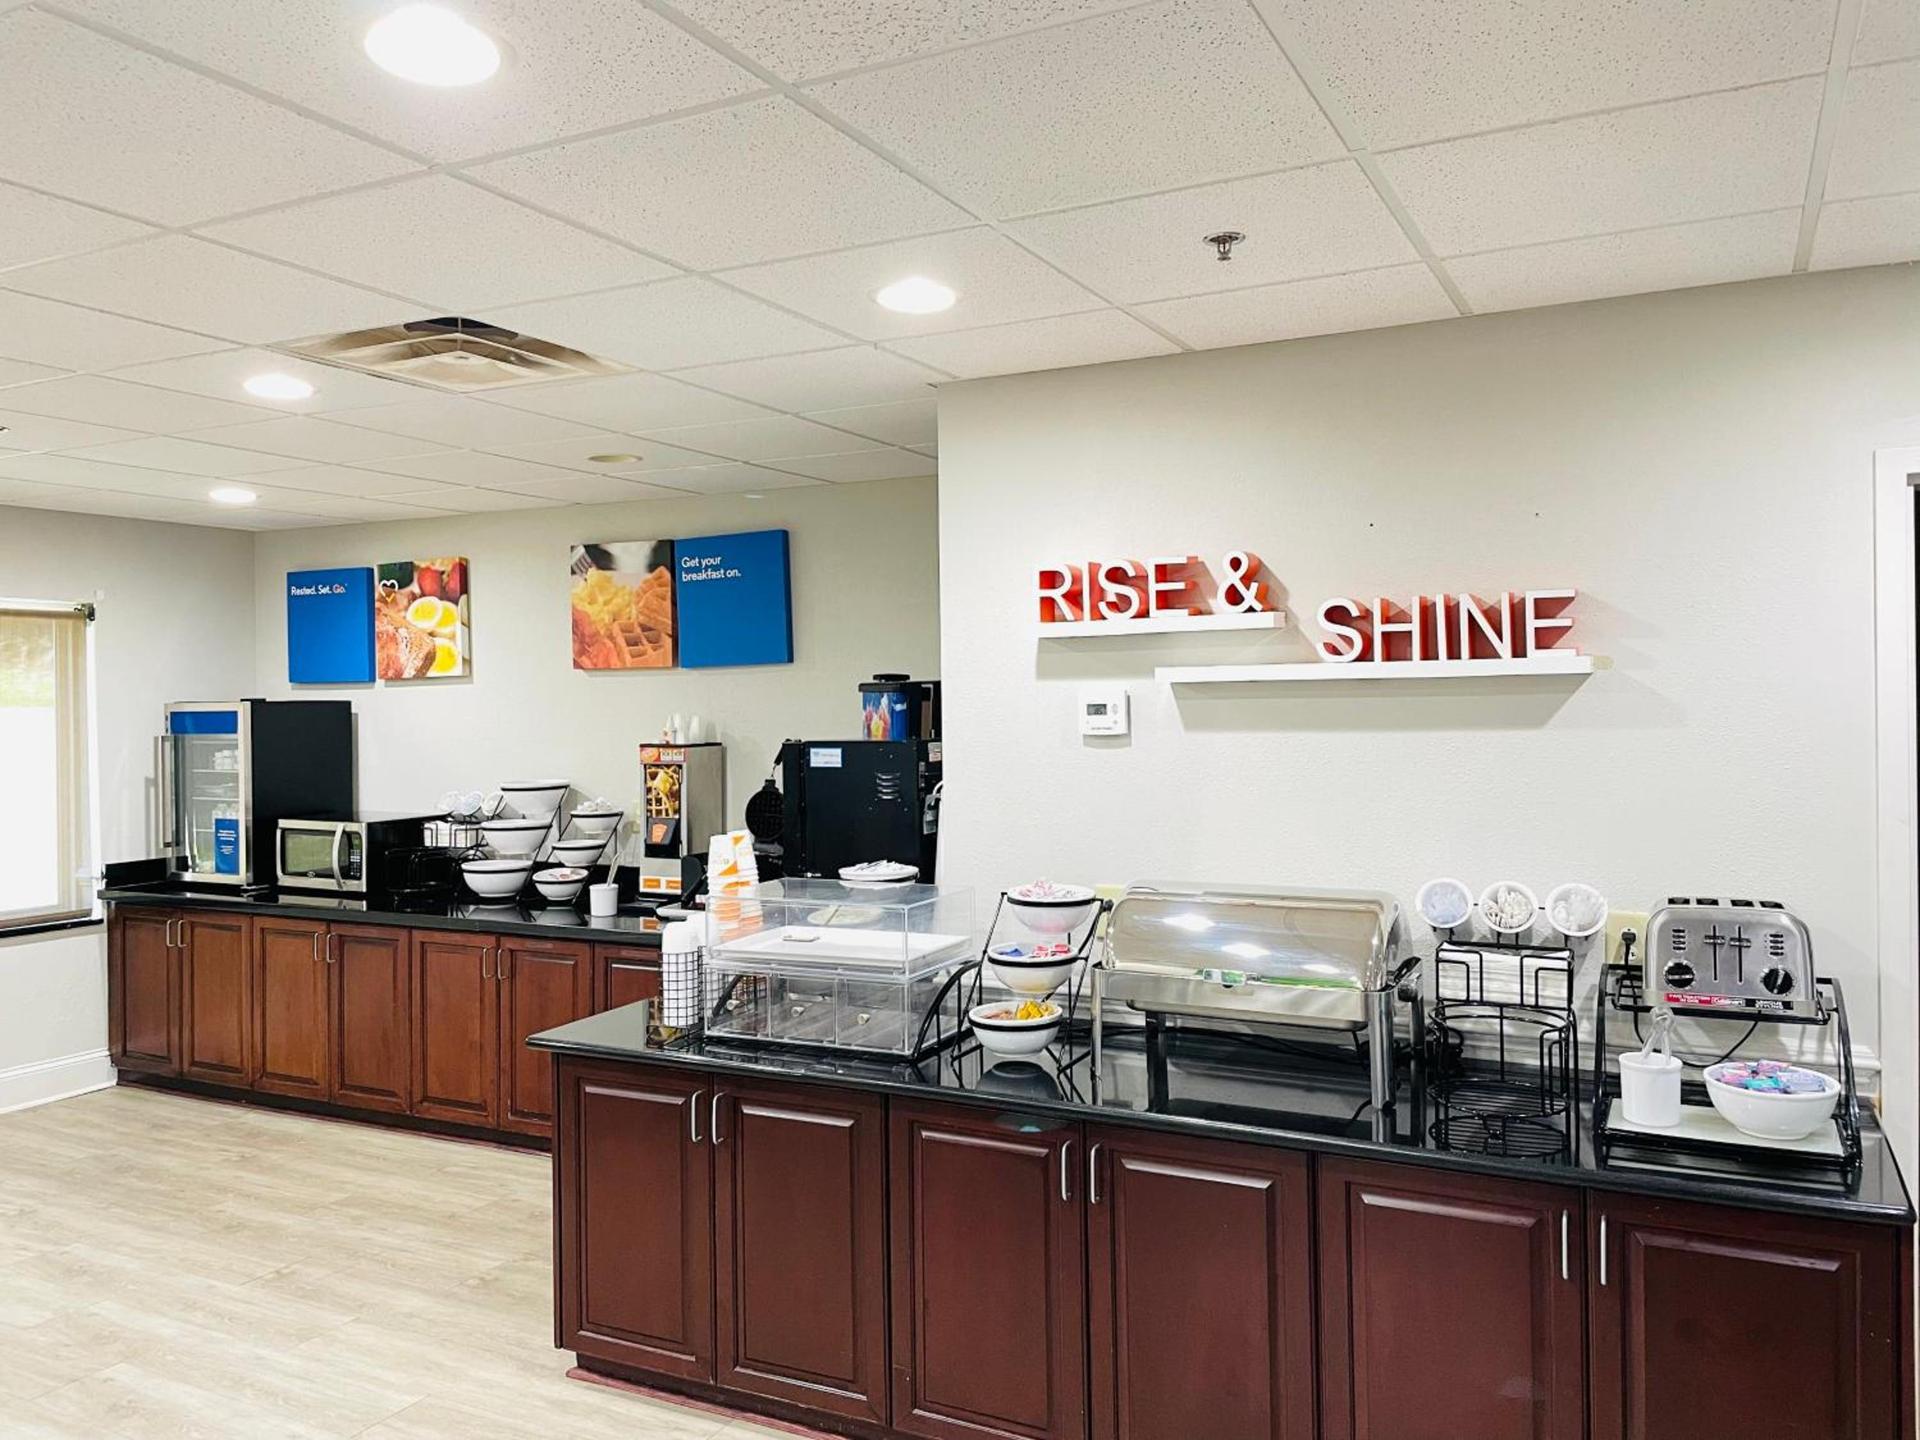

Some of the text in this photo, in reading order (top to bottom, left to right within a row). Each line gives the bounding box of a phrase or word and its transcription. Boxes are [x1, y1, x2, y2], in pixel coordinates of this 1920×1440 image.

[681, 556, 722, 569] Get your
[682, 568, 741, 582] breakfast on.
[318, 584, 332, 594] Set.
[1036, 550, 1266, 622] RISE &
[1315, 589, 1577, 663] SHINE
